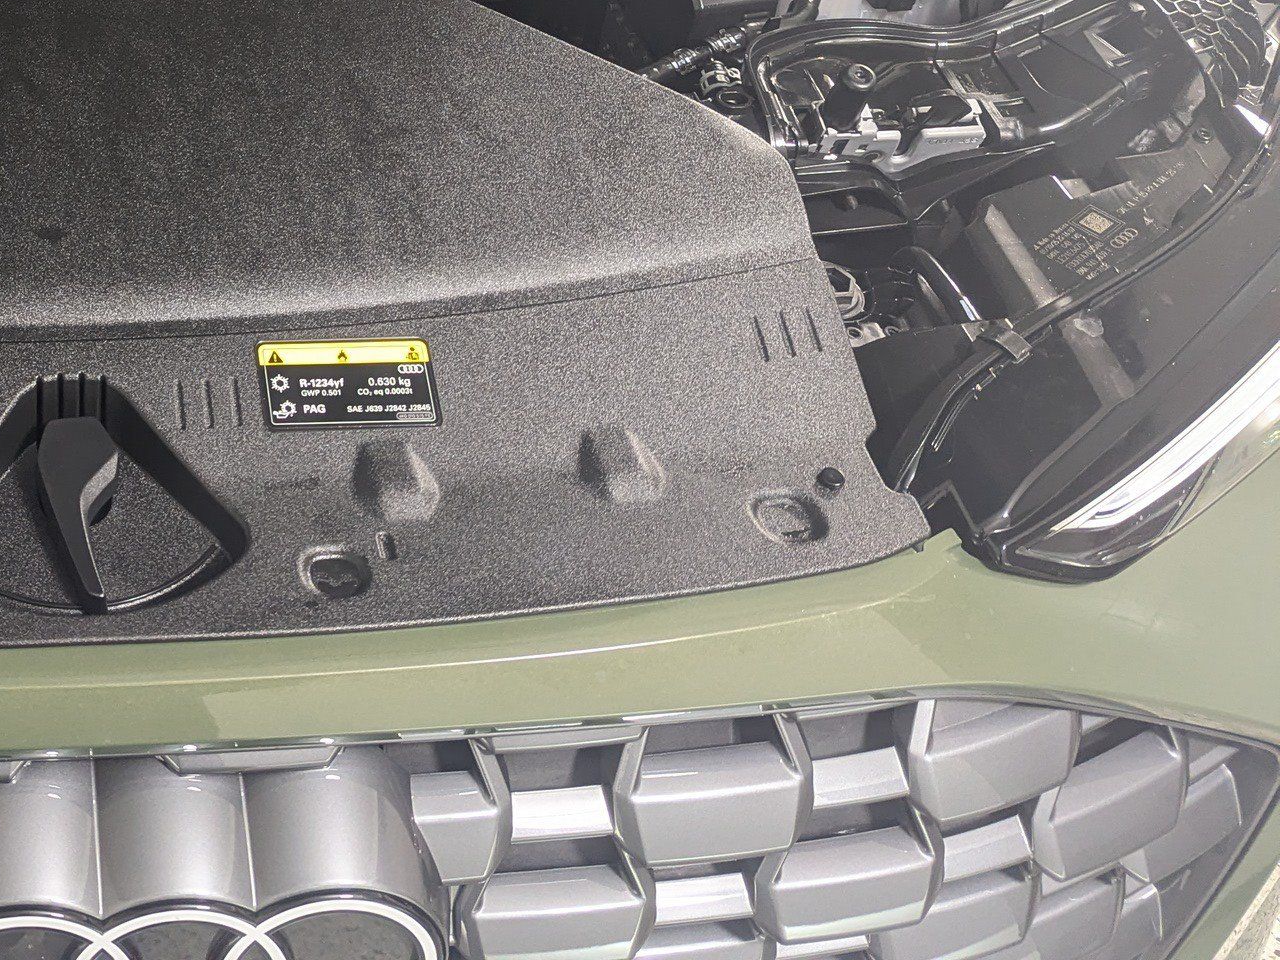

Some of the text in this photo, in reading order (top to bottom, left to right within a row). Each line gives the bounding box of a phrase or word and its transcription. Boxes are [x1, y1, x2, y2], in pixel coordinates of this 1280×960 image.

[299, 378, 344, 388] R-1234yf
[368, 377, 411, 387] 0.630 kg
[303, 404, 326, 413] PAG
[384, 404, 407, 412] J2842
